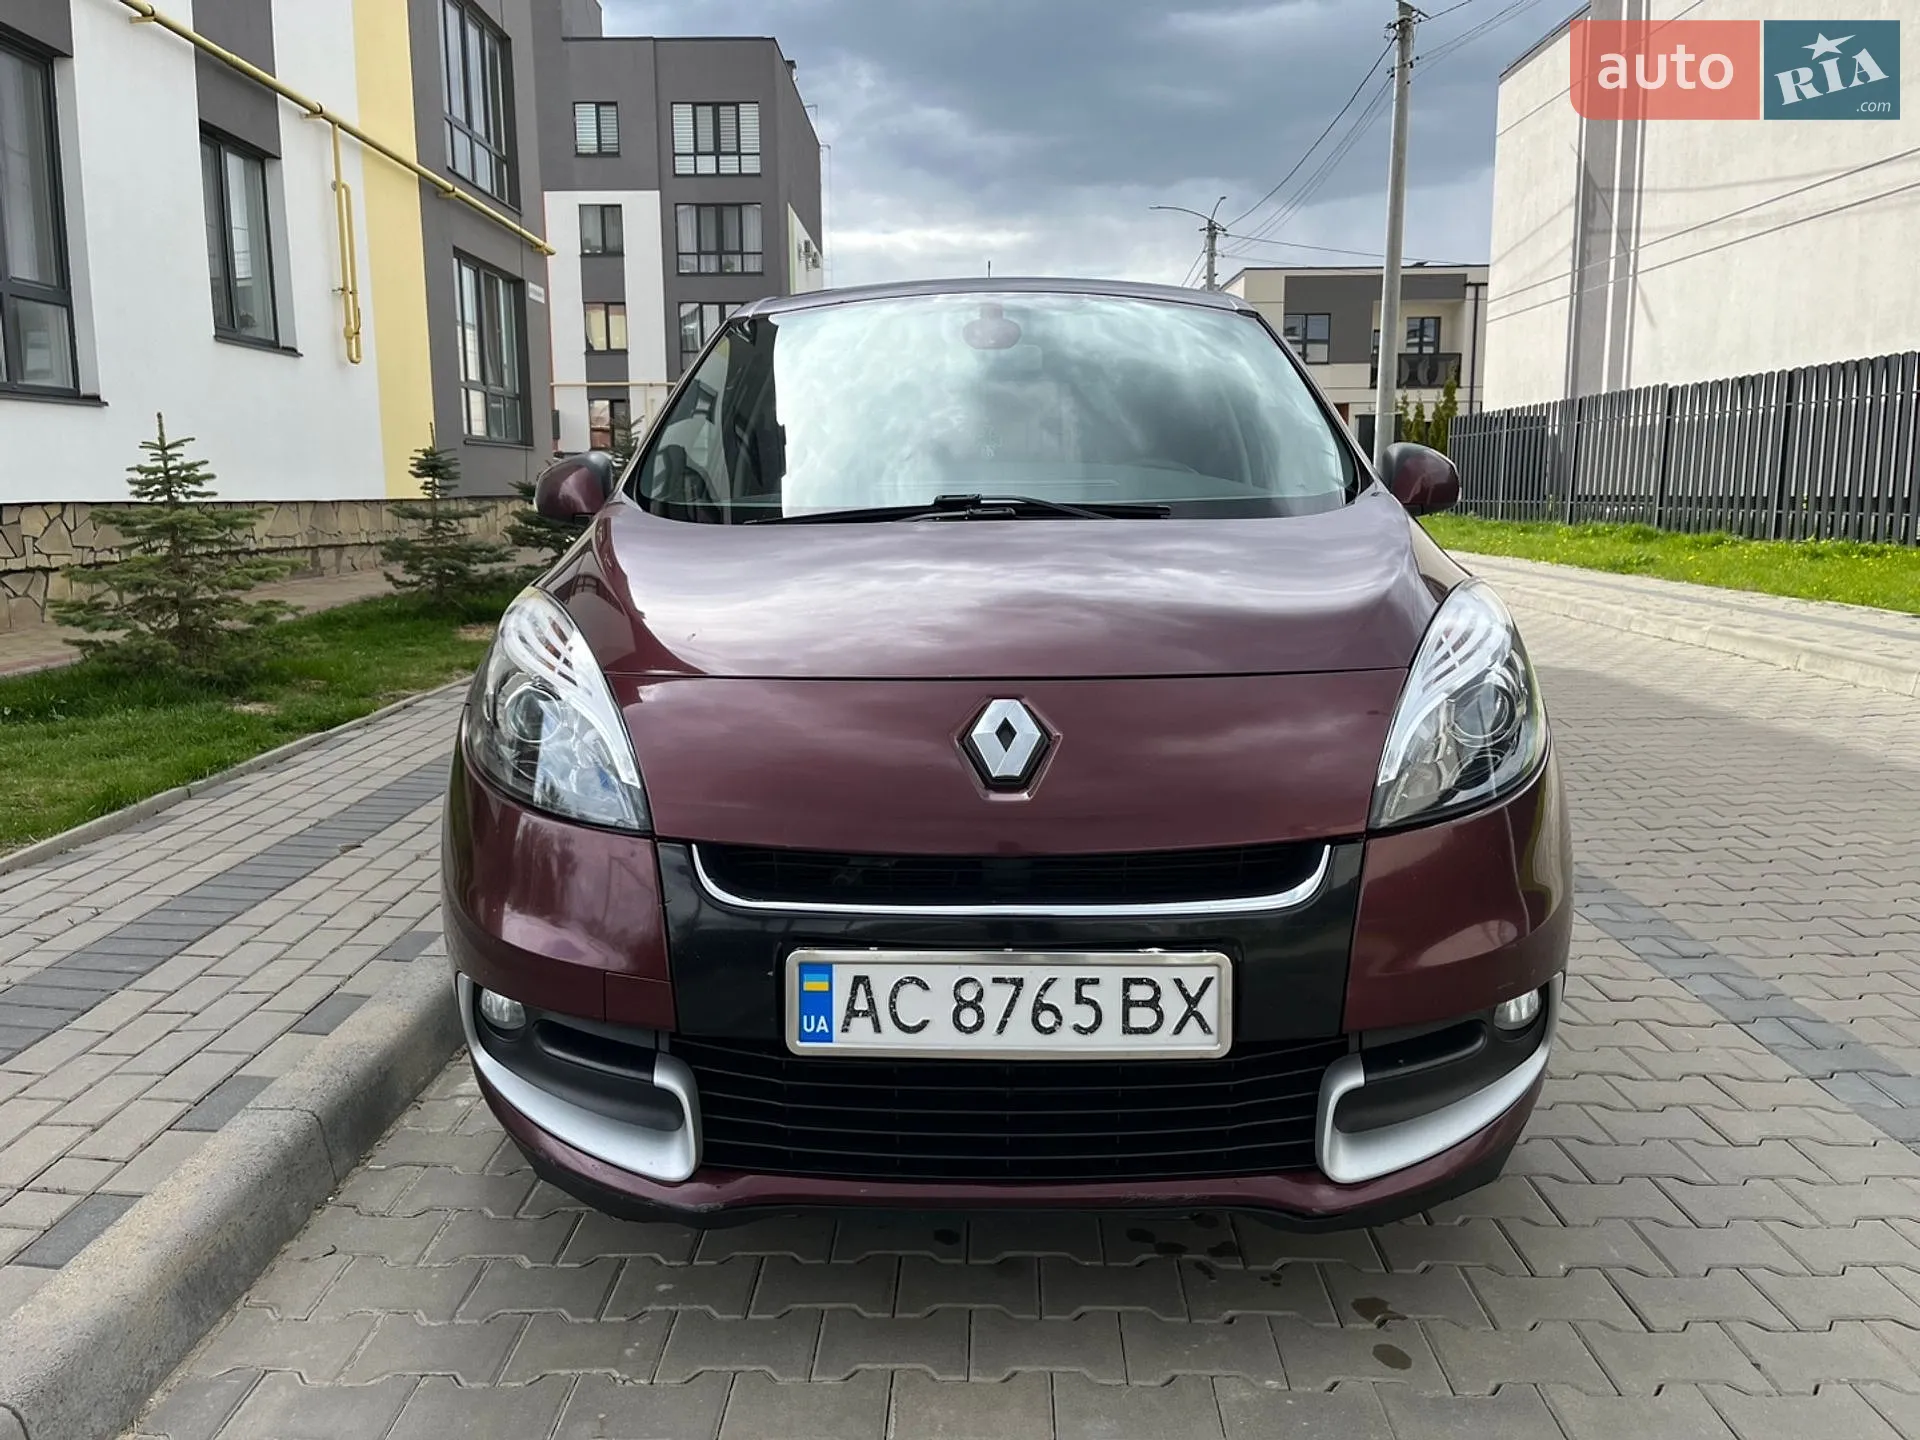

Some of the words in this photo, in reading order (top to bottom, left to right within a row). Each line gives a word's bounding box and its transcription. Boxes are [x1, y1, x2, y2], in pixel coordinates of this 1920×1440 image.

[803, 1015, 829, 1034] UA
[840, 975, 931, 1035] AC
[951, 976, 1103, 1036] 8765
[1121, 976, 1215, 1036] BX
